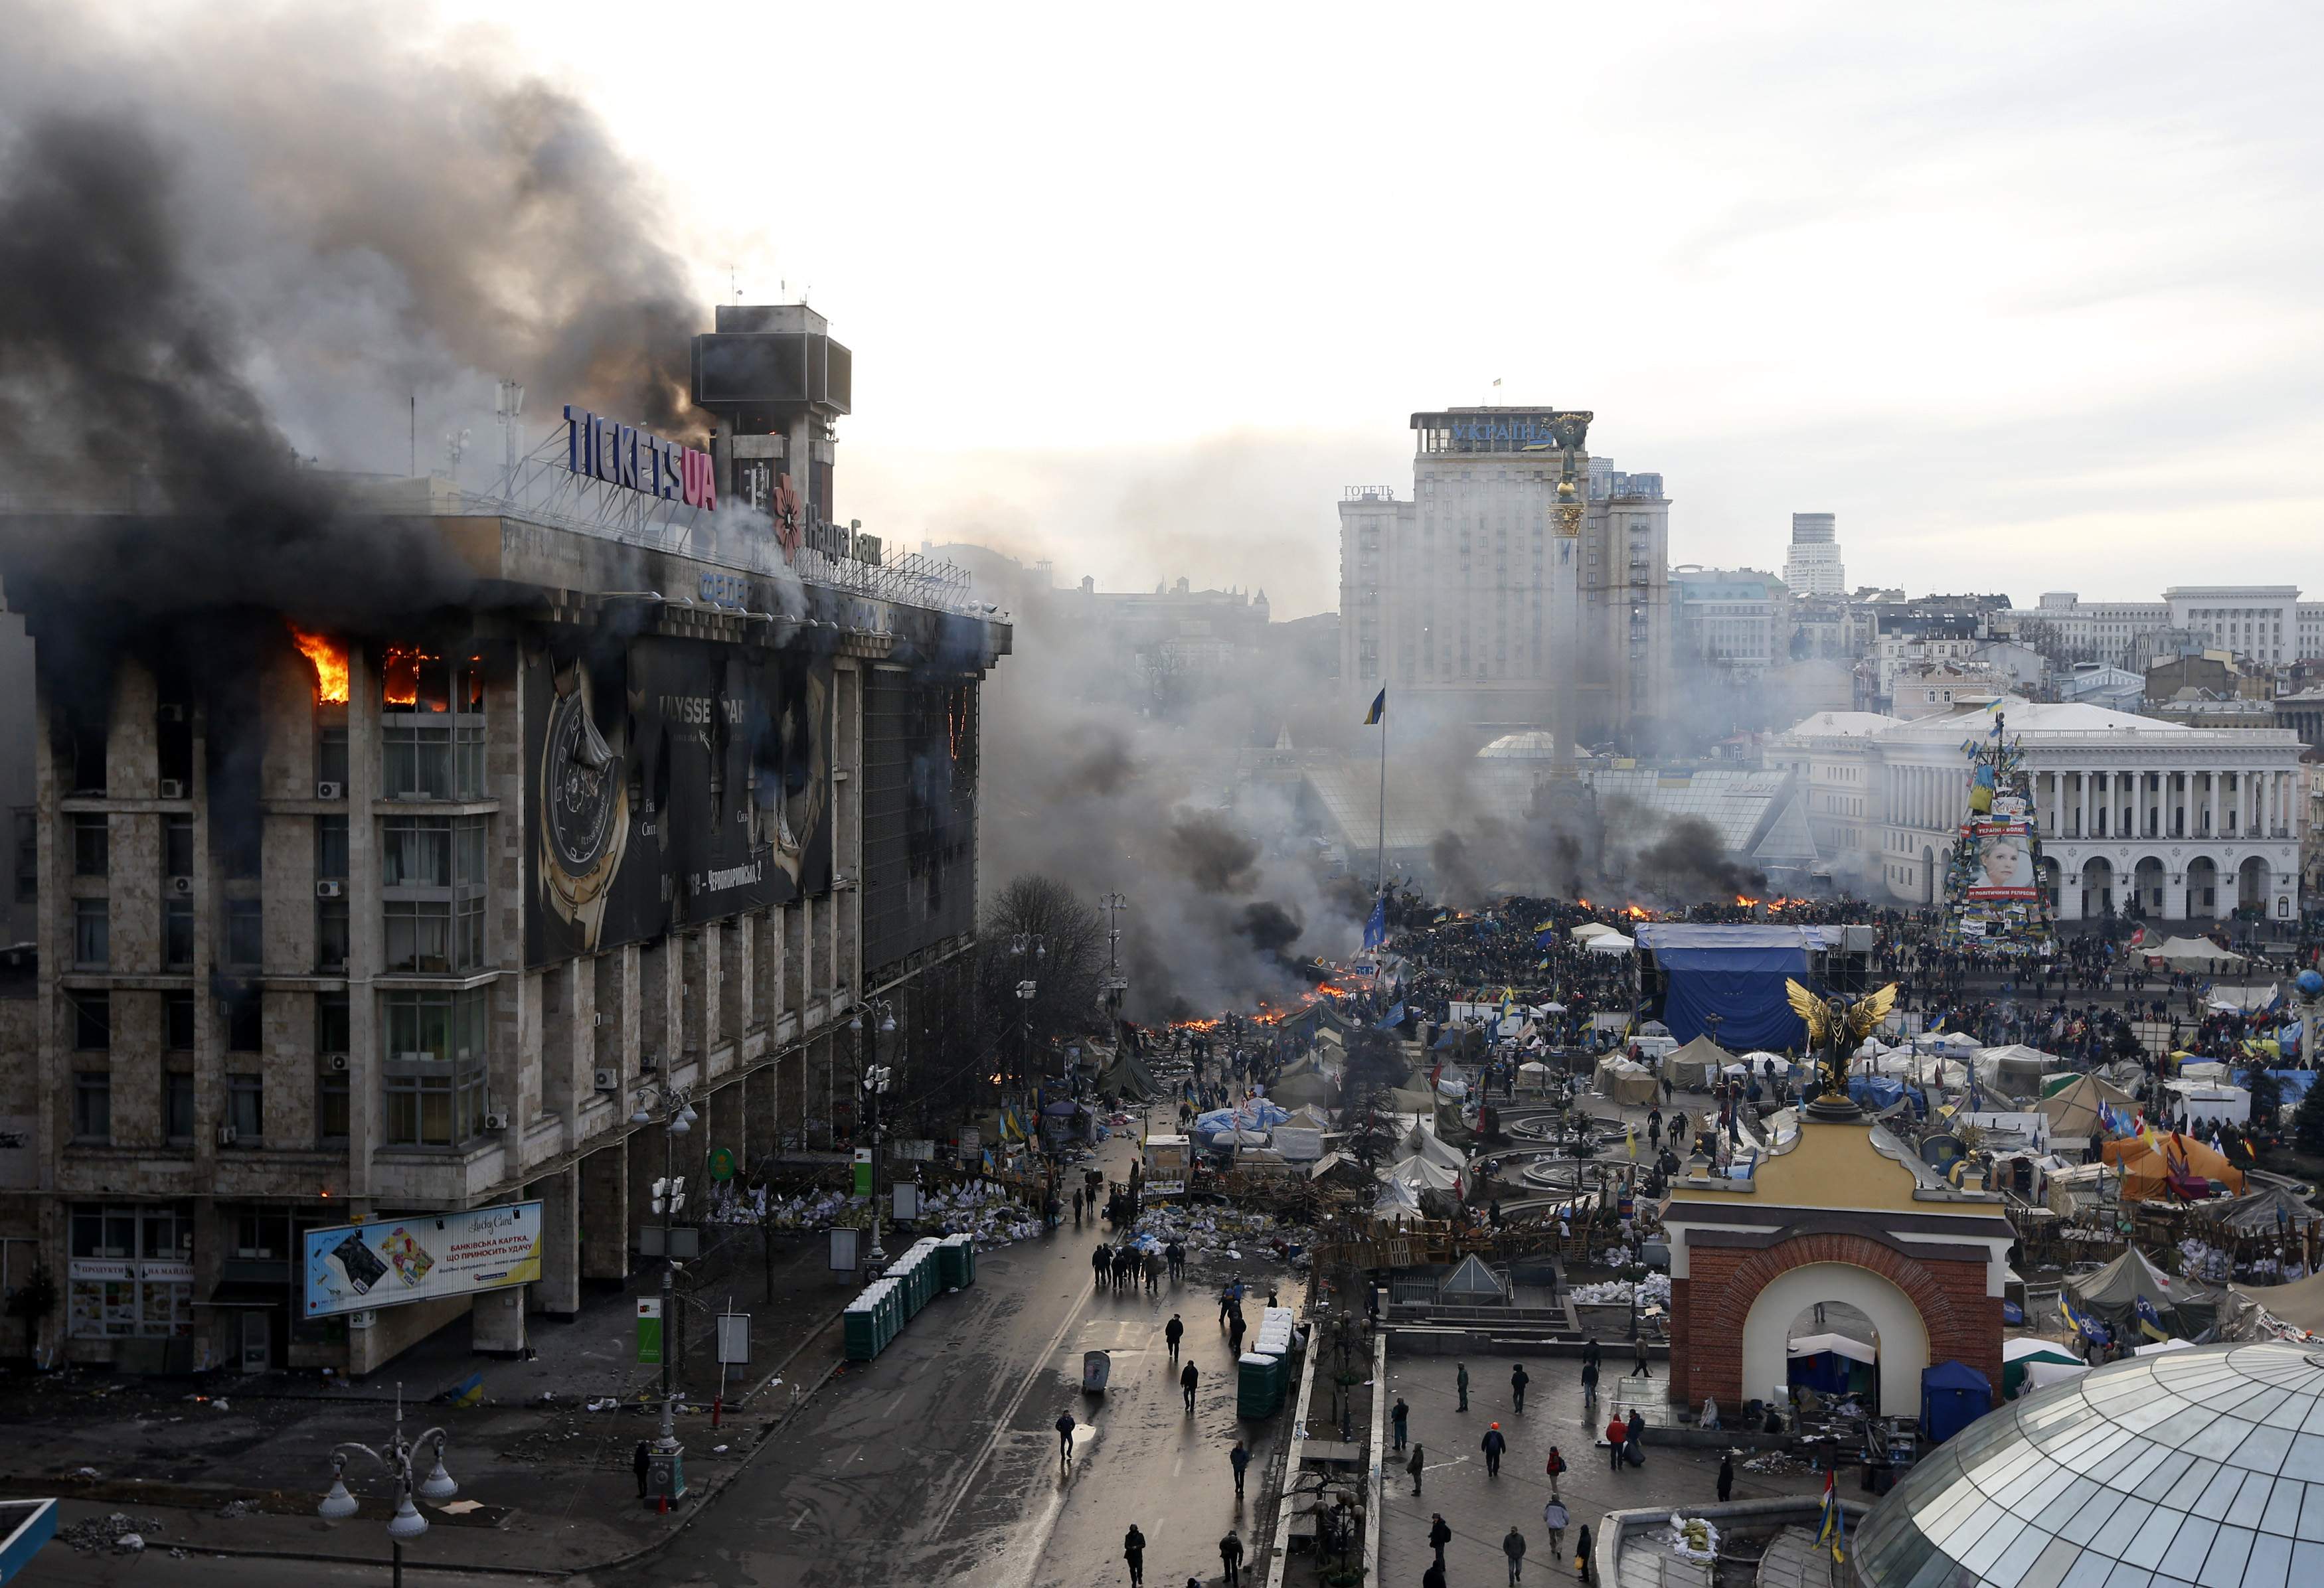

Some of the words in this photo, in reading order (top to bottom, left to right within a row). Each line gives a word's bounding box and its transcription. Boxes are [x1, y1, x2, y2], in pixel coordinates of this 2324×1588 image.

[1452, 422, 1553, 440] УКРАЇНА
[1344, 485, 1394, 496] ГОТЕЛЬ
[805, 503, 850, 566] Надра
[851, 520, 882, 566] Банк
[659, 696, 712, 724] ULYSSE
[758, 860, 762, 881] 2
[451, 1239, 497, 1251] БАНКІВСЬКА
[499, 1235, 529, 1245] КАРТКА,
[461, 1248, 507, 1259] ПРИНОСИТЬ
[509, 1244, 532, 1253] УДАЧУ
[82, 1265, 125, 1275] ПРОДУКТИ
